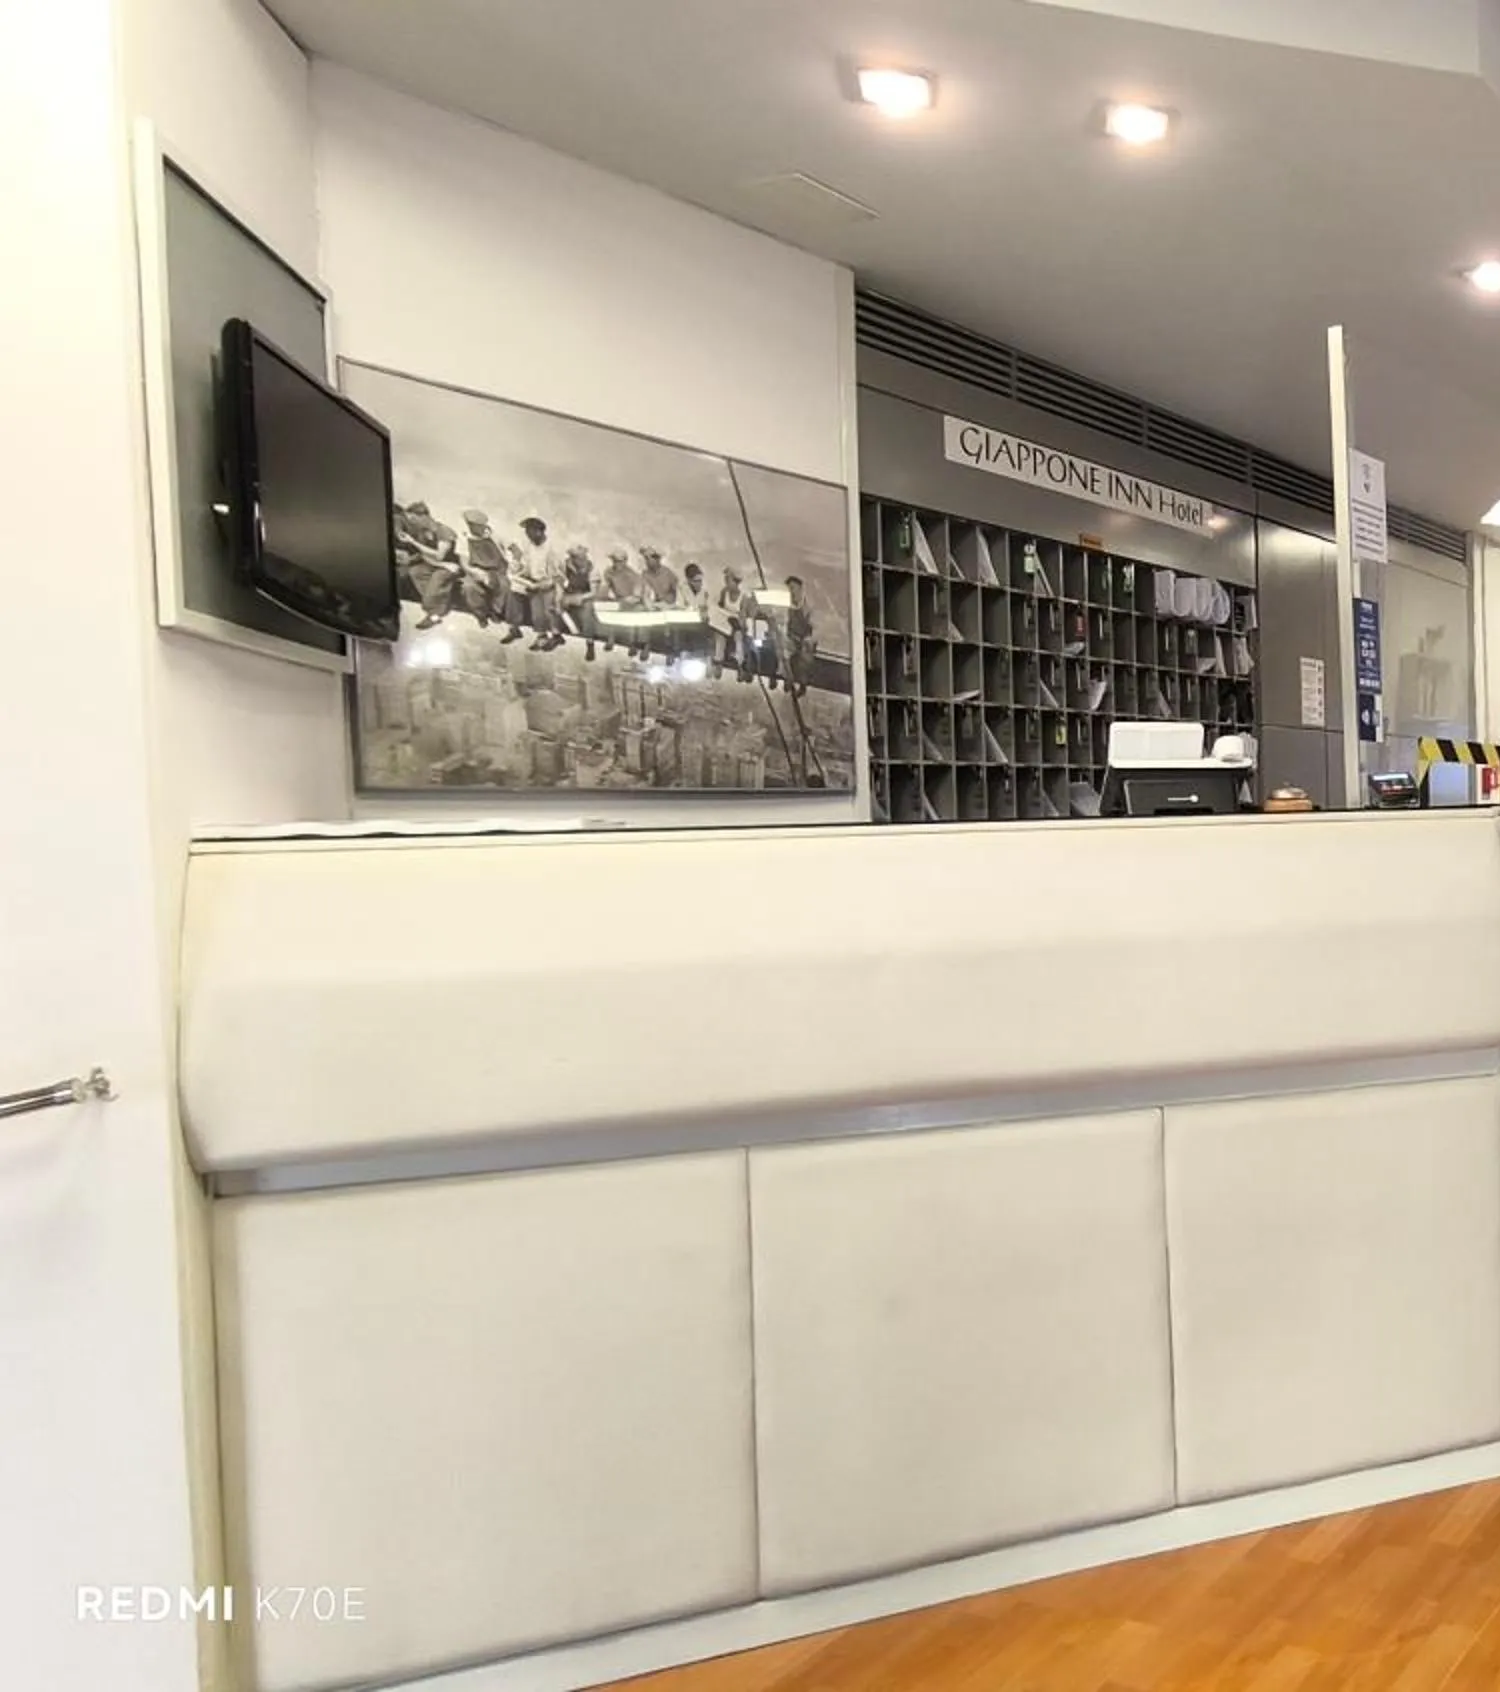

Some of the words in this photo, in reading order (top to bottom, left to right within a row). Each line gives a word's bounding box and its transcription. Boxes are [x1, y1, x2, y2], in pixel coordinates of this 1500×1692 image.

[959, 427, 1101, 495] GIAPPONE
[1108, 471, 1152, 511] INN
[1159, 489, 1203, 527] Hotel
